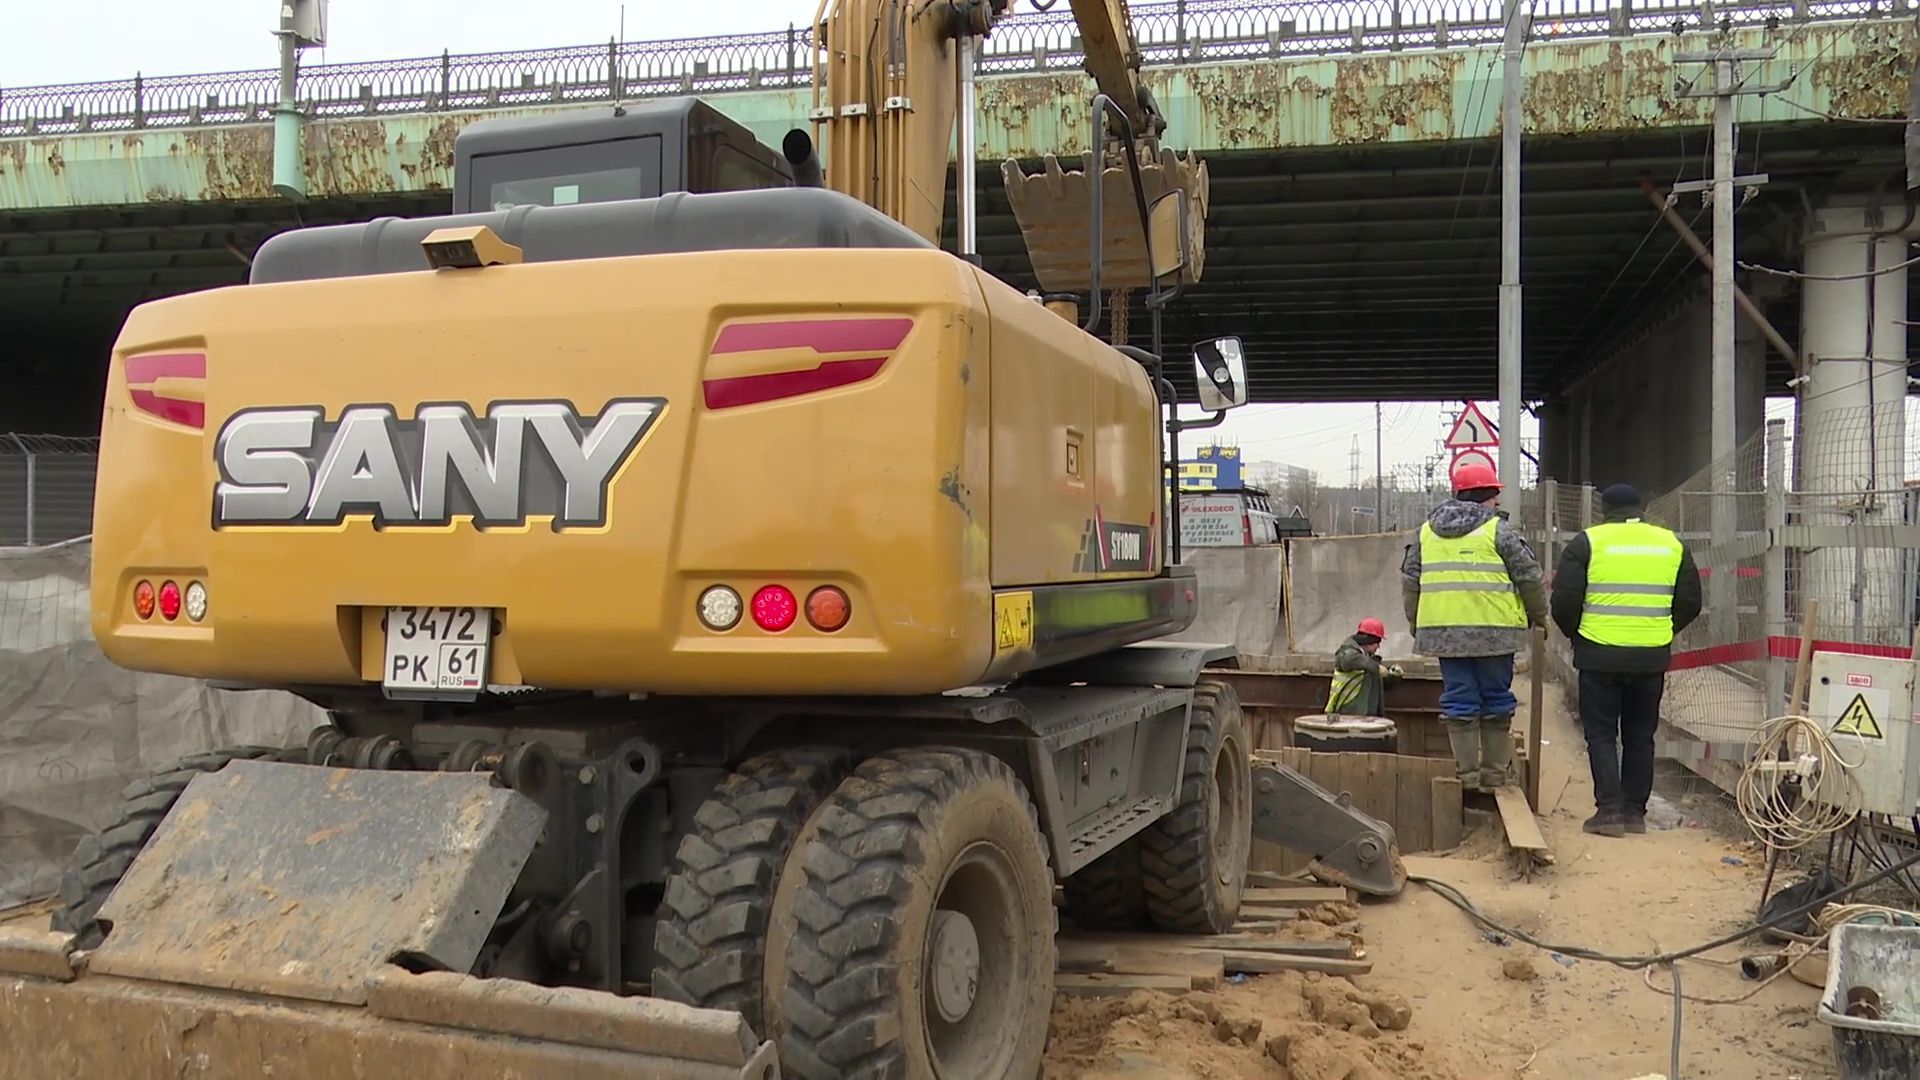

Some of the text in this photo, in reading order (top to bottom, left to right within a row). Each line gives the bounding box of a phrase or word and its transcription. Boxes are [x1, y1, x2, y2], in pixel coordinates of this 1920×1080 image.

[215, 399, 665, 525] SANY
[1111, 531, 1140, 560] SY180W
[400, 607, 476, 640] 3472
[448, 647, 478, 674] 61
[441, 675, 463, 686] RUS
